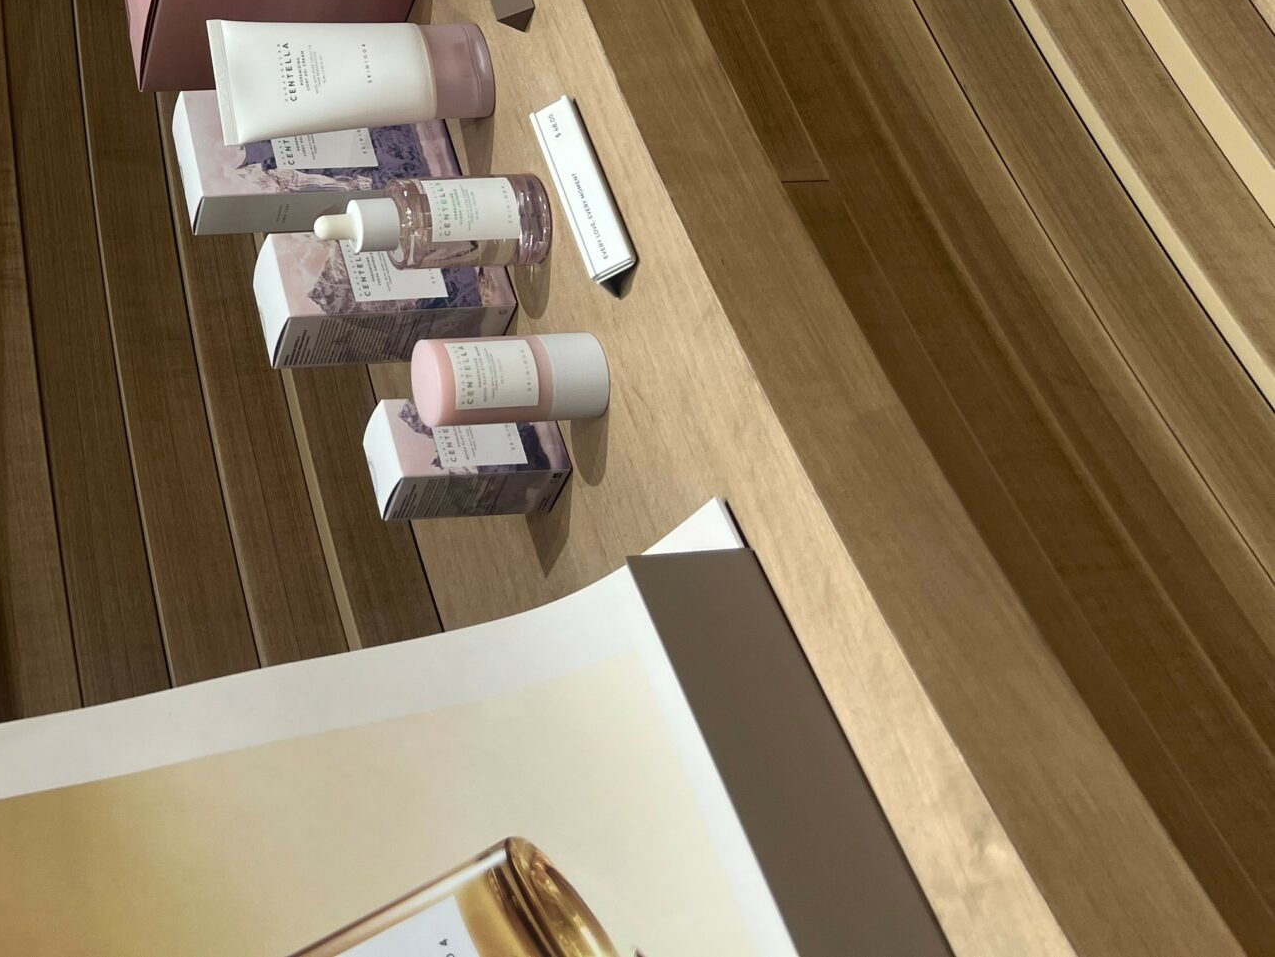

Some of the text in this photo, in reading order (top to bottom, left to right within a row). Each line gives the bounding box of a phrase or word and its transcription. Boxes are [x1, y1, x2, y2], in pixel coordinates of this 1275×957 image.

[282, 42, 298, 102] CENTELLA
[571, 173, 586, 199] MOMENT
[582, 199, 594, 219] EVERY
[597, 239, 609, 260] EVERY
[458, 346, 474, 405] CENTELLA
